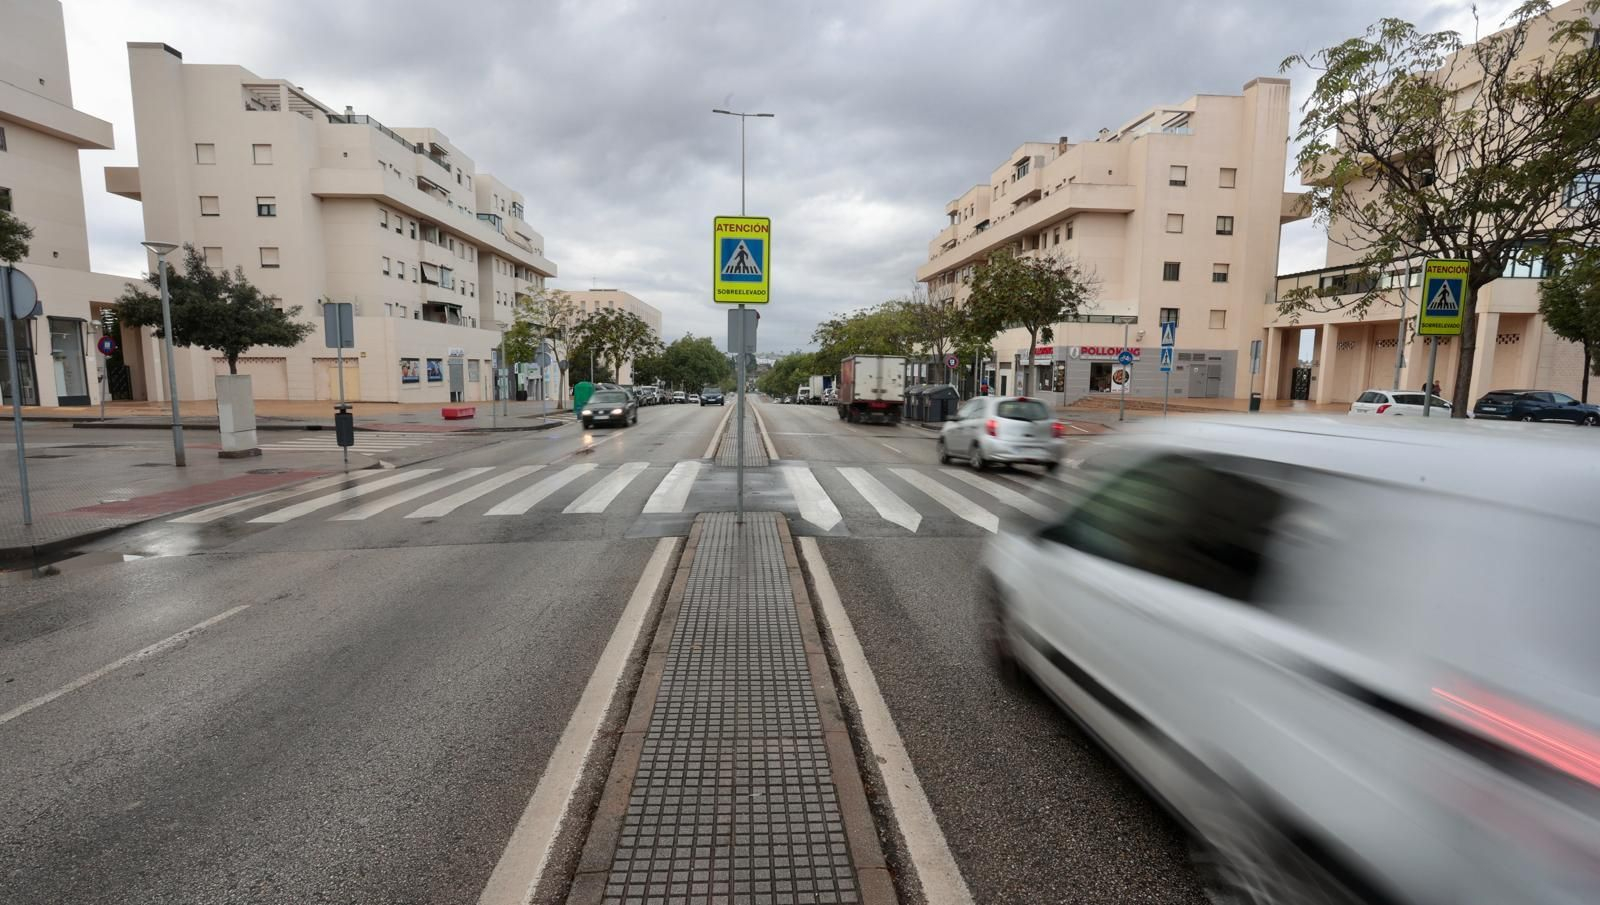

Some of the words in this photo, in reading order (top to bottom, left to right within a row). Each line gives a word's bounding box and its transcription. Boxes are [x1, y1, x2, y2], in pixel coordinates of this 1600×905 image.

[716, 222, 768, 233] ATENCIÓN
[1427, 264, 1468, 274] ATENCIÓN
[1081, 346, 1141, 357] POLLOKNG
